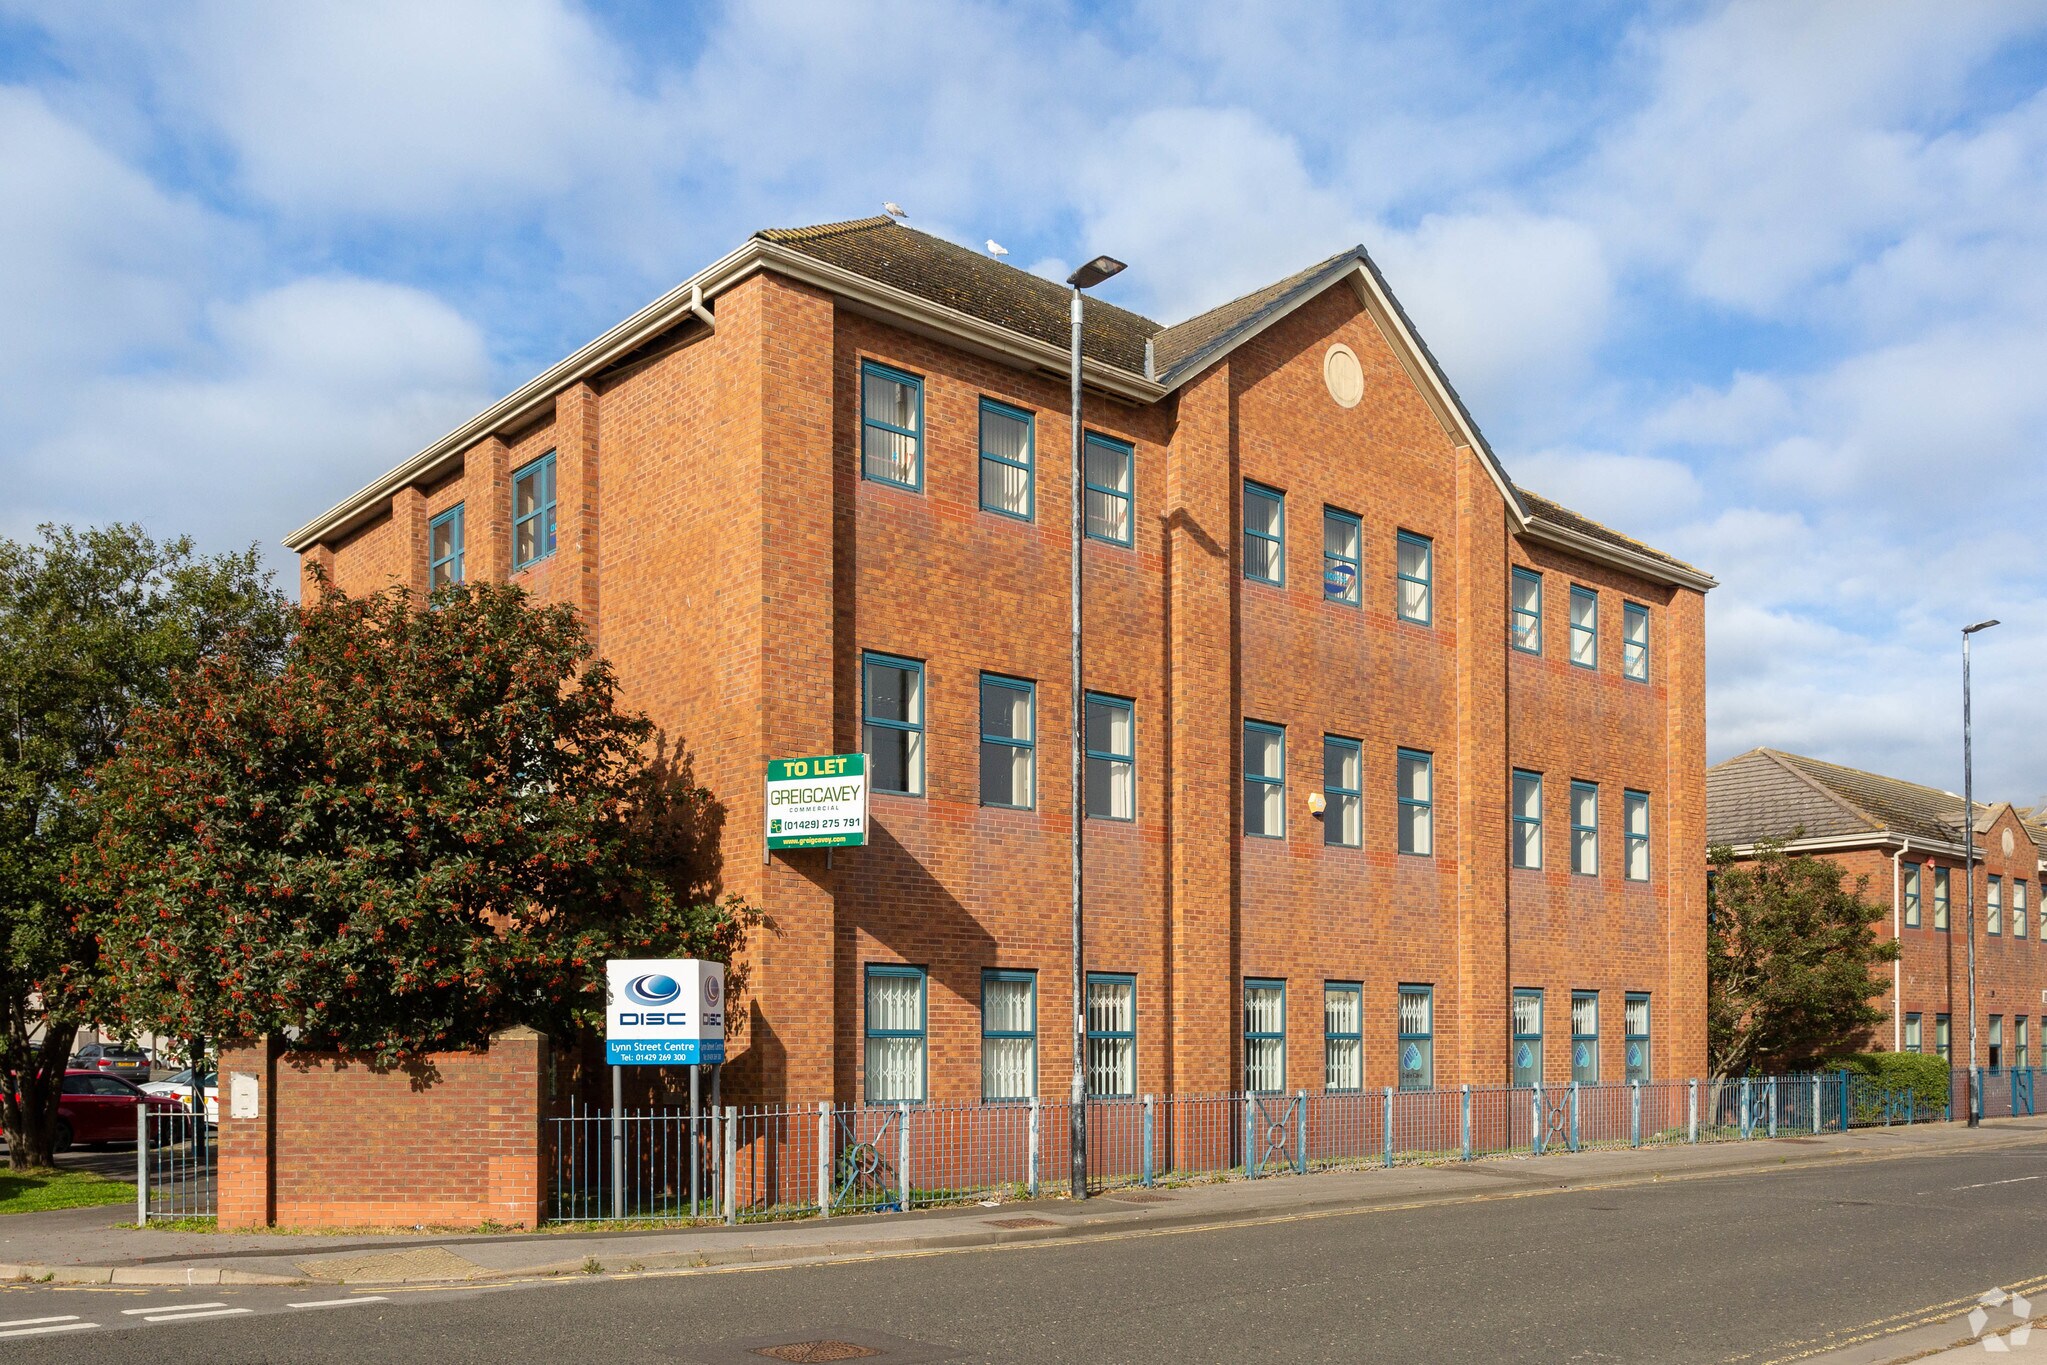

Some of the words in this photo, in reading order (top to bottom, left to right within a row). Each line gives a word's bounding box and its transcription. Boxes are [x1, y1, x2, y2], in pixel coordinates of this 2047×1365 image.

[784, 761, 808, 777] TO
[814, 758, 847, 775] LET
[771, 785, 860, 805] GREIGCAVEY
[789, 805, 839, 813] COMMERCIAL
[784, 820, 819, 831] (01429)
[822, 819, 840, 828] 275
[843, 818, 860, 827] 791
[783, 836, 846, 846] www.greigcavey.com
[620, 1013, 686, 1026] DISC
[612, 1043, 631, 1052] Lynn
[634, 1042, 662, 1051] Street
[664, 1042, 695, 1051] Centre
